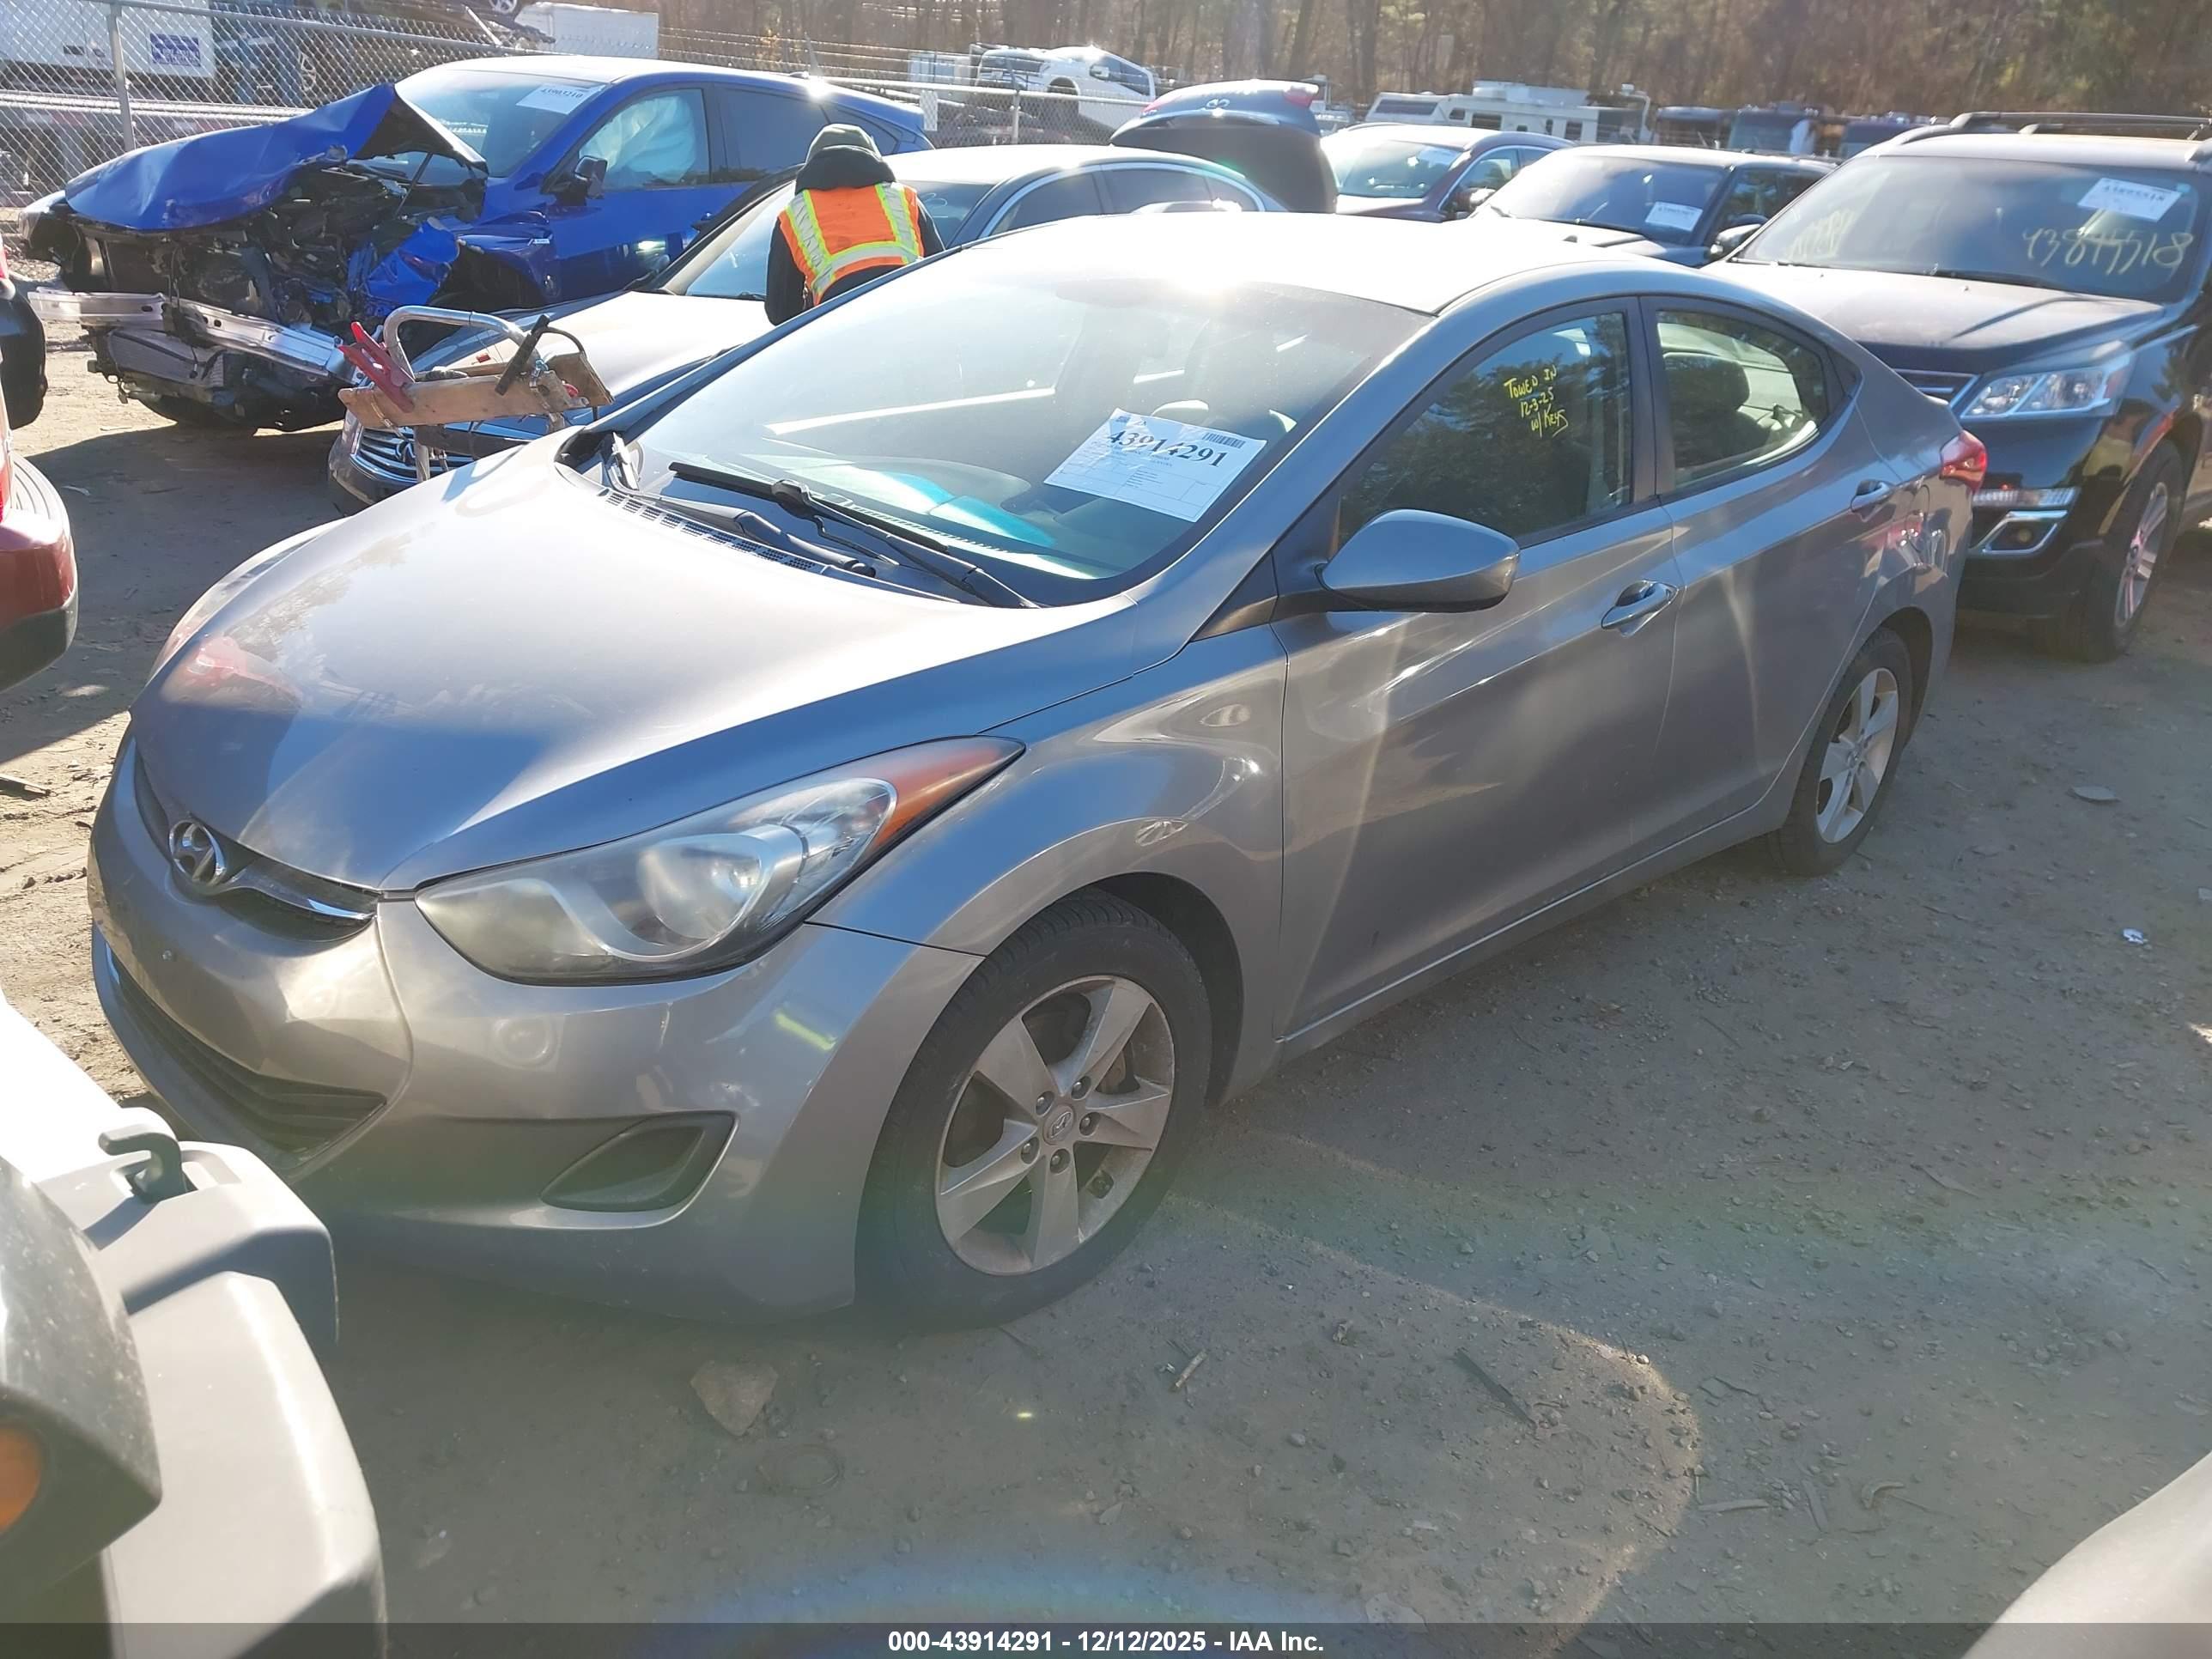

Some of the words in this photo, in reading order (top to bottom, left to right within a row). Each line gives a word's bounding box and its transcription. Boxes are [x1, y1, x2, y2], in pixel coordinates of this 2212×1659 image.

[1544, 364, 1557, 380] IN
[1520, 386, 1554, 418] 12-3-25
[1107, 430, 1229, 468] 43914291
